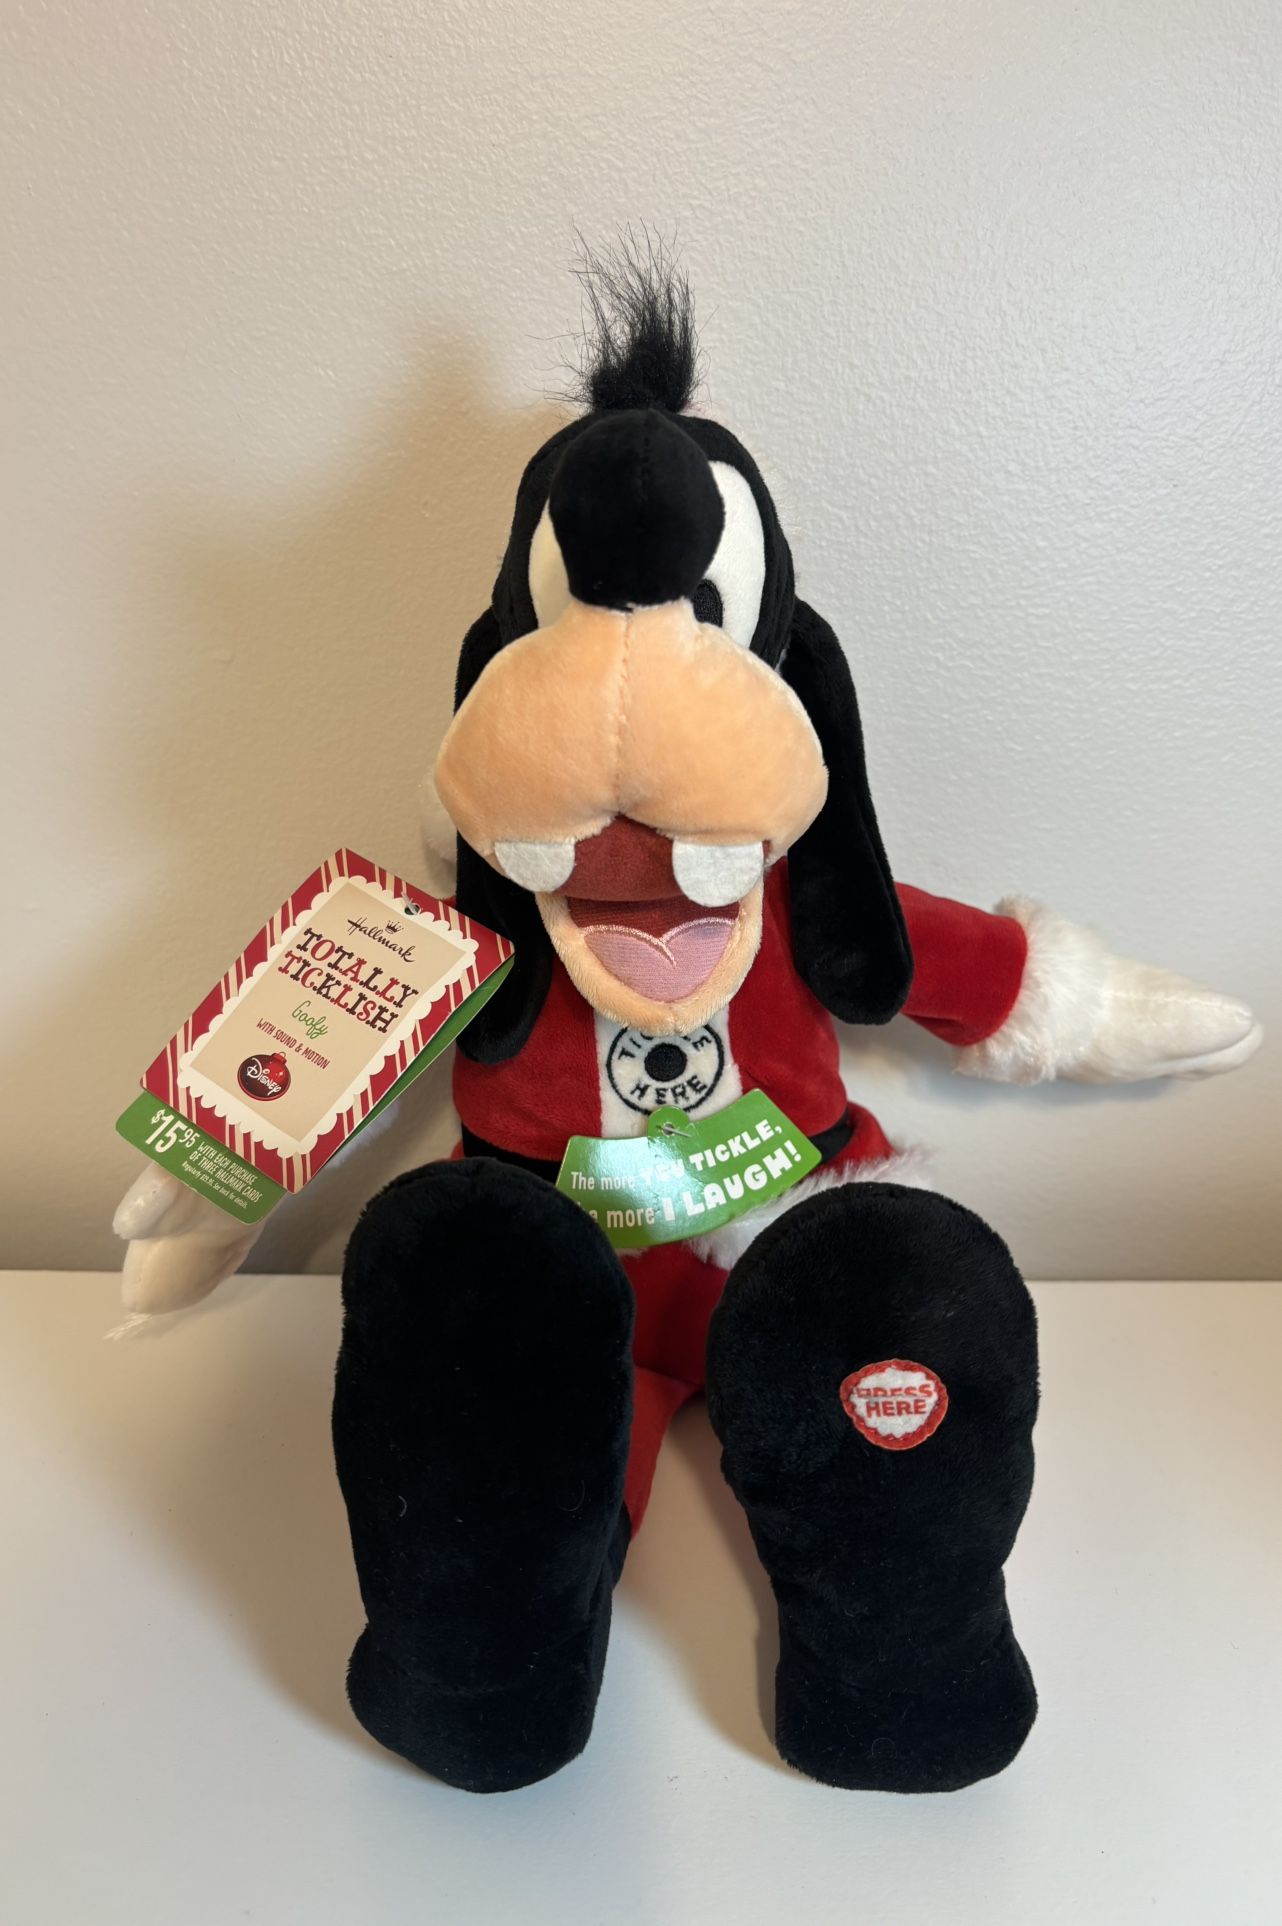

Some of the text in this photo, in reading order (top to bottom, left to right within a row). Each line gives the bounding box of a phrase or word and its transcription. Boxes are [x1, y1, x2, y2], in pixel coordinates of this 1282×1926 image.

[347, 917, 415, 962] Hallmark
[278, 950, 398, 1033] TICKLISH
[296, 928, 419, 1008] TOTALLY
[256, 1018, 331, 1069] WITH SOUND & MOTION
[291, 1000, 328, 1039] Goofy
[630, 1075, 707, 1106] HERE
[189, 1151, 263, 1203] OF THREE HALLMARK CARDS
[197, 1141, 258, 1185] WITH EACH PURCHASE
[571, 1171, 594, 1190] The
[601, 1174, 635, 1190] more
[689, 1119, 783, 1171] TICKLE,
[607, 1207, 655, 1228] more
[661, 1197, 676, 1221] I
[682, 1140, 801, 1216] LAUGH!
[866, 1399, 927, 1418] HERE
